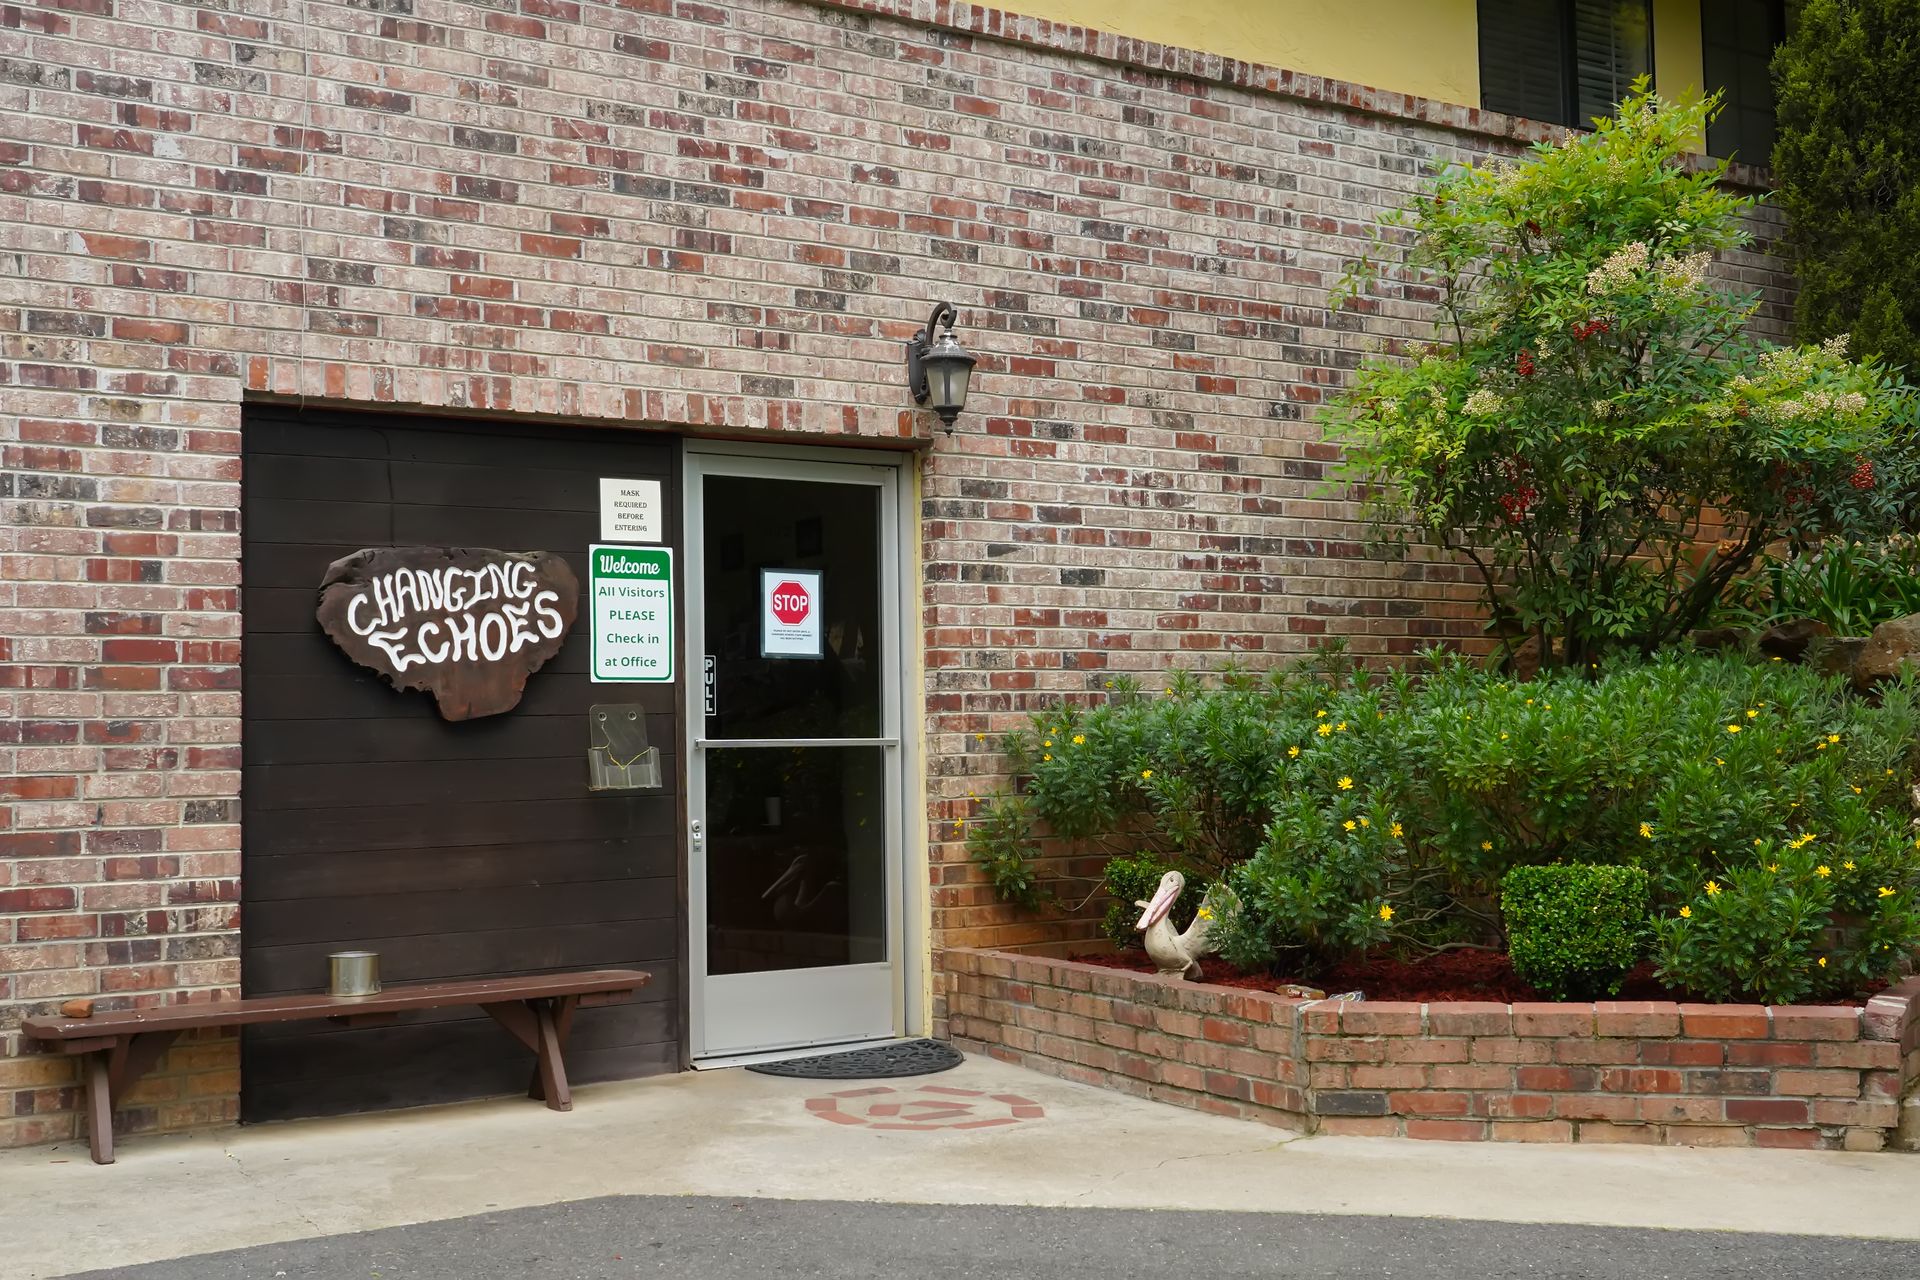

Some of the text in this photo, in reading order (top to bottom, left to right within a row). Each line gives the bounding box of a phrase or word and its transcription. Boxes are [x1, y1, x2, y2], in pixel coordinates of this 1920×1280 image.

[620, 489, 640, 497] MASK
[614, 501, 647, 509] REQUIRED
[614, 524, 647, 532] ENTERING
[600, 554, 660, 575] Welcome
[598, 586, 665, 598] All Visitors
[347, 560, 537, 636] CHANGING
[774, 594, 808, 612] STOP
[609, 610, 655, 621] PLEASE
[368, 591, 563, 672] ECHOES
[606, 633, 660, 644] Check in
[604, 656, 657, 667] at Office
[704, 659, 714, 712] PULL
